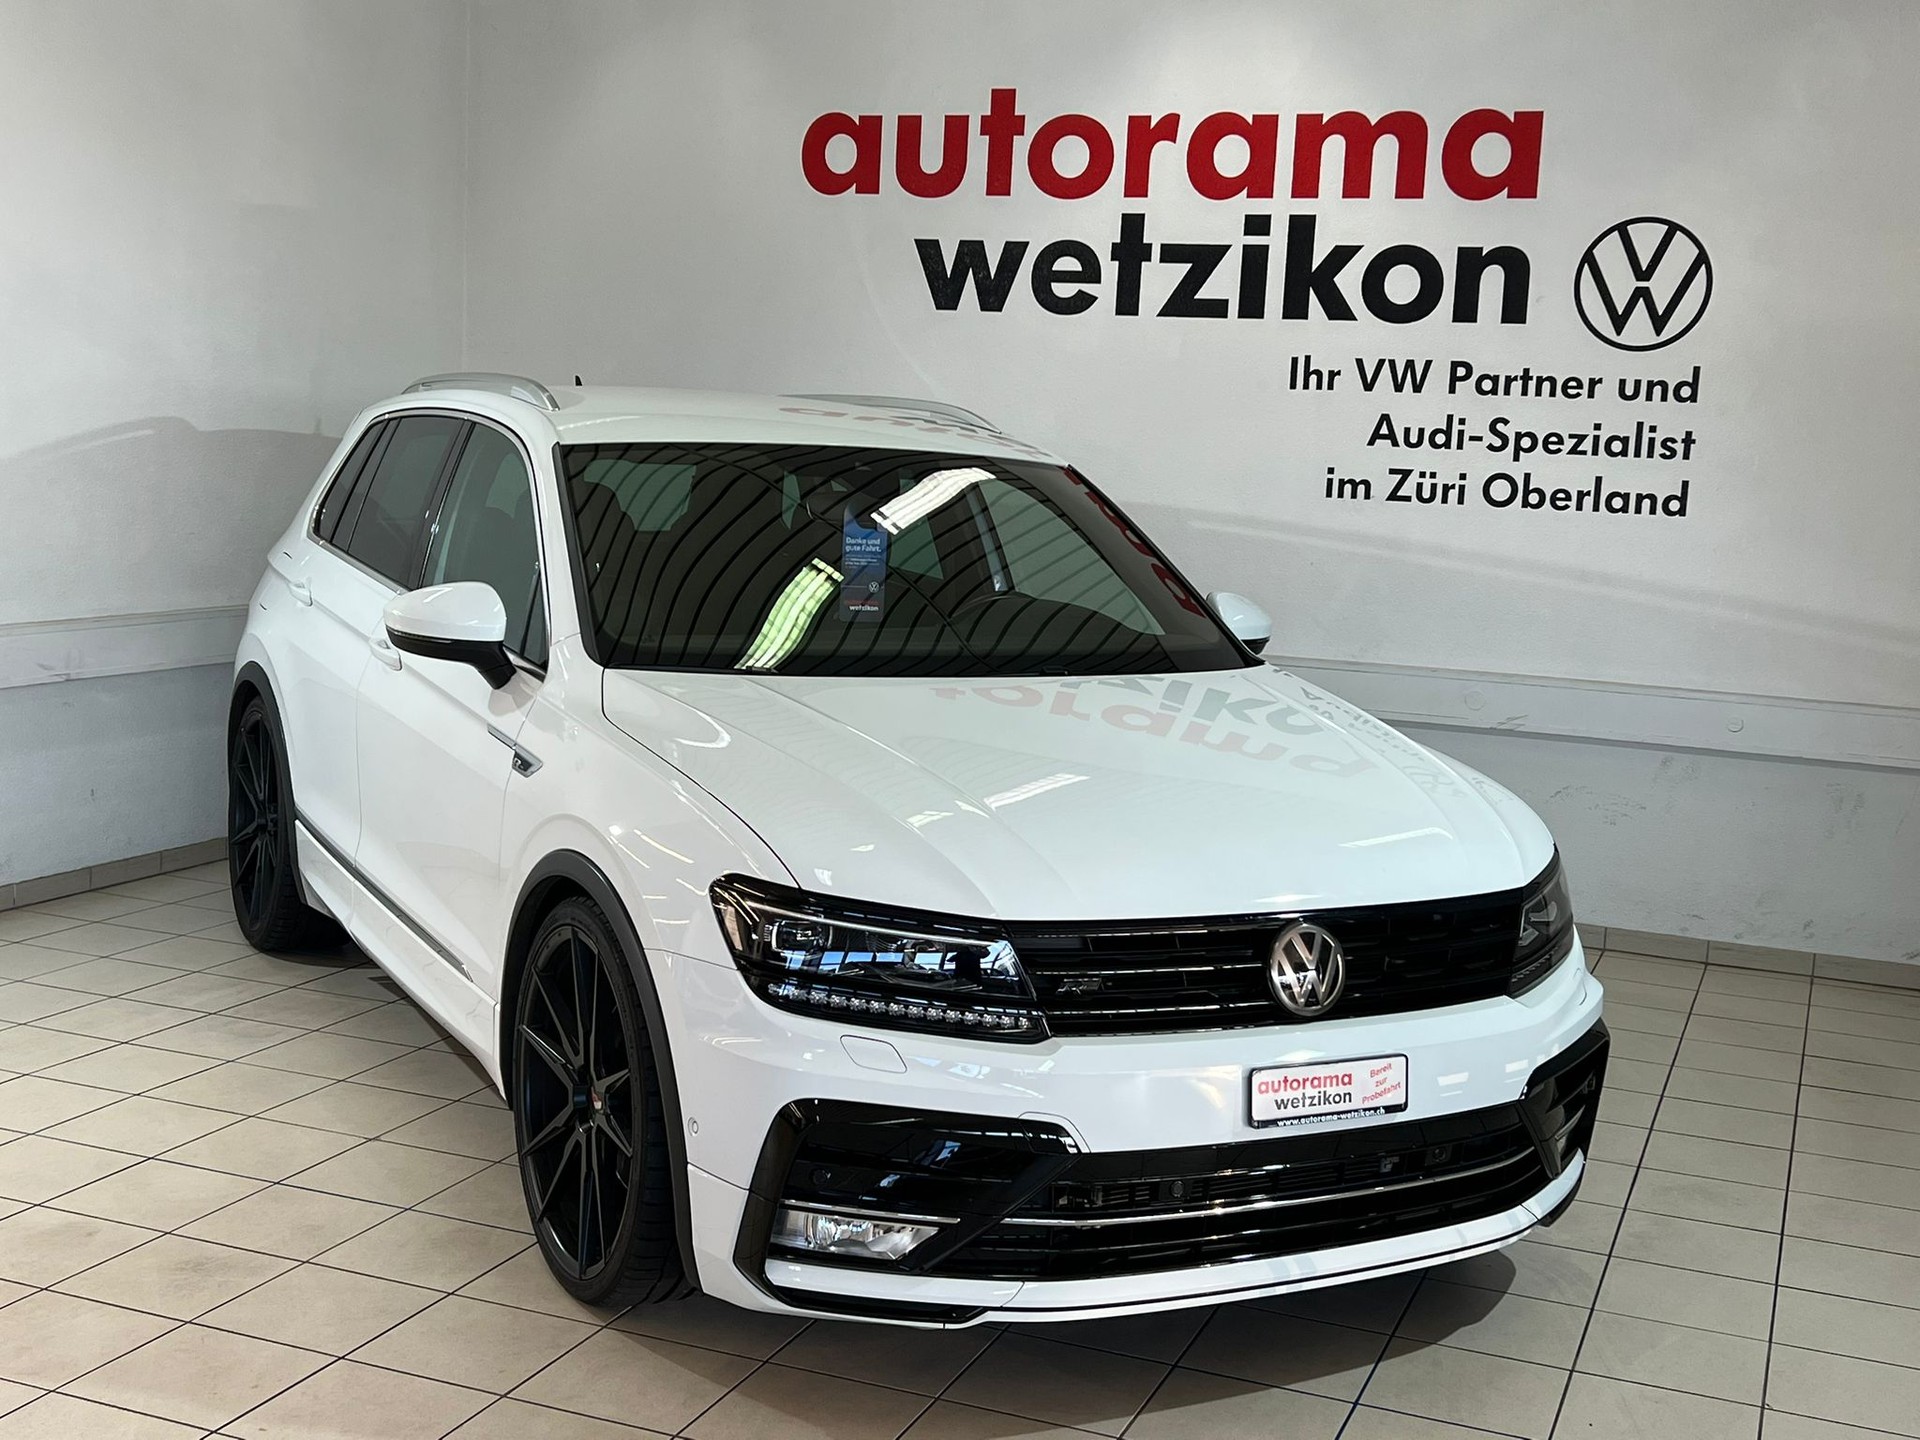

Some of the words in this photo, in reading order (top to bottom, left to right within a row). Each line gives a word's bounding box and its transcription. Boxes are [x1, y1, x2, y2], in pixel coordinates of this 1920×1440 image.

[803, 89, 1545, 202] autorama
[915, 213, 1532, 325] wetzikon
[1289, 355, 1341, 391] Ihr
[1355, 358, 1433, 394] VW
[1448, 360, 1603, 399] Partner
[1618, 365, 1702, 404] und
[1366, 413, 1697, 463] Audi-Spezialist
[1325, 467, 1373, 501] im
[1386, 468, 1468, 506] Züri
[1482, 472, 1690, 518] Oberland
[1369, 1062, 1393, 1079] Bereit
[1375, 1076, 1388, 1088] zur
[1257, 1073, 1353, 1095] autorama
[1361, 1081, 1402, 1105] Probefahrt
[1274, 1090, 1353, 1111] wetzikon
[1276, 1107, 1386, 1128] www.autorama-wetzikon.ch
